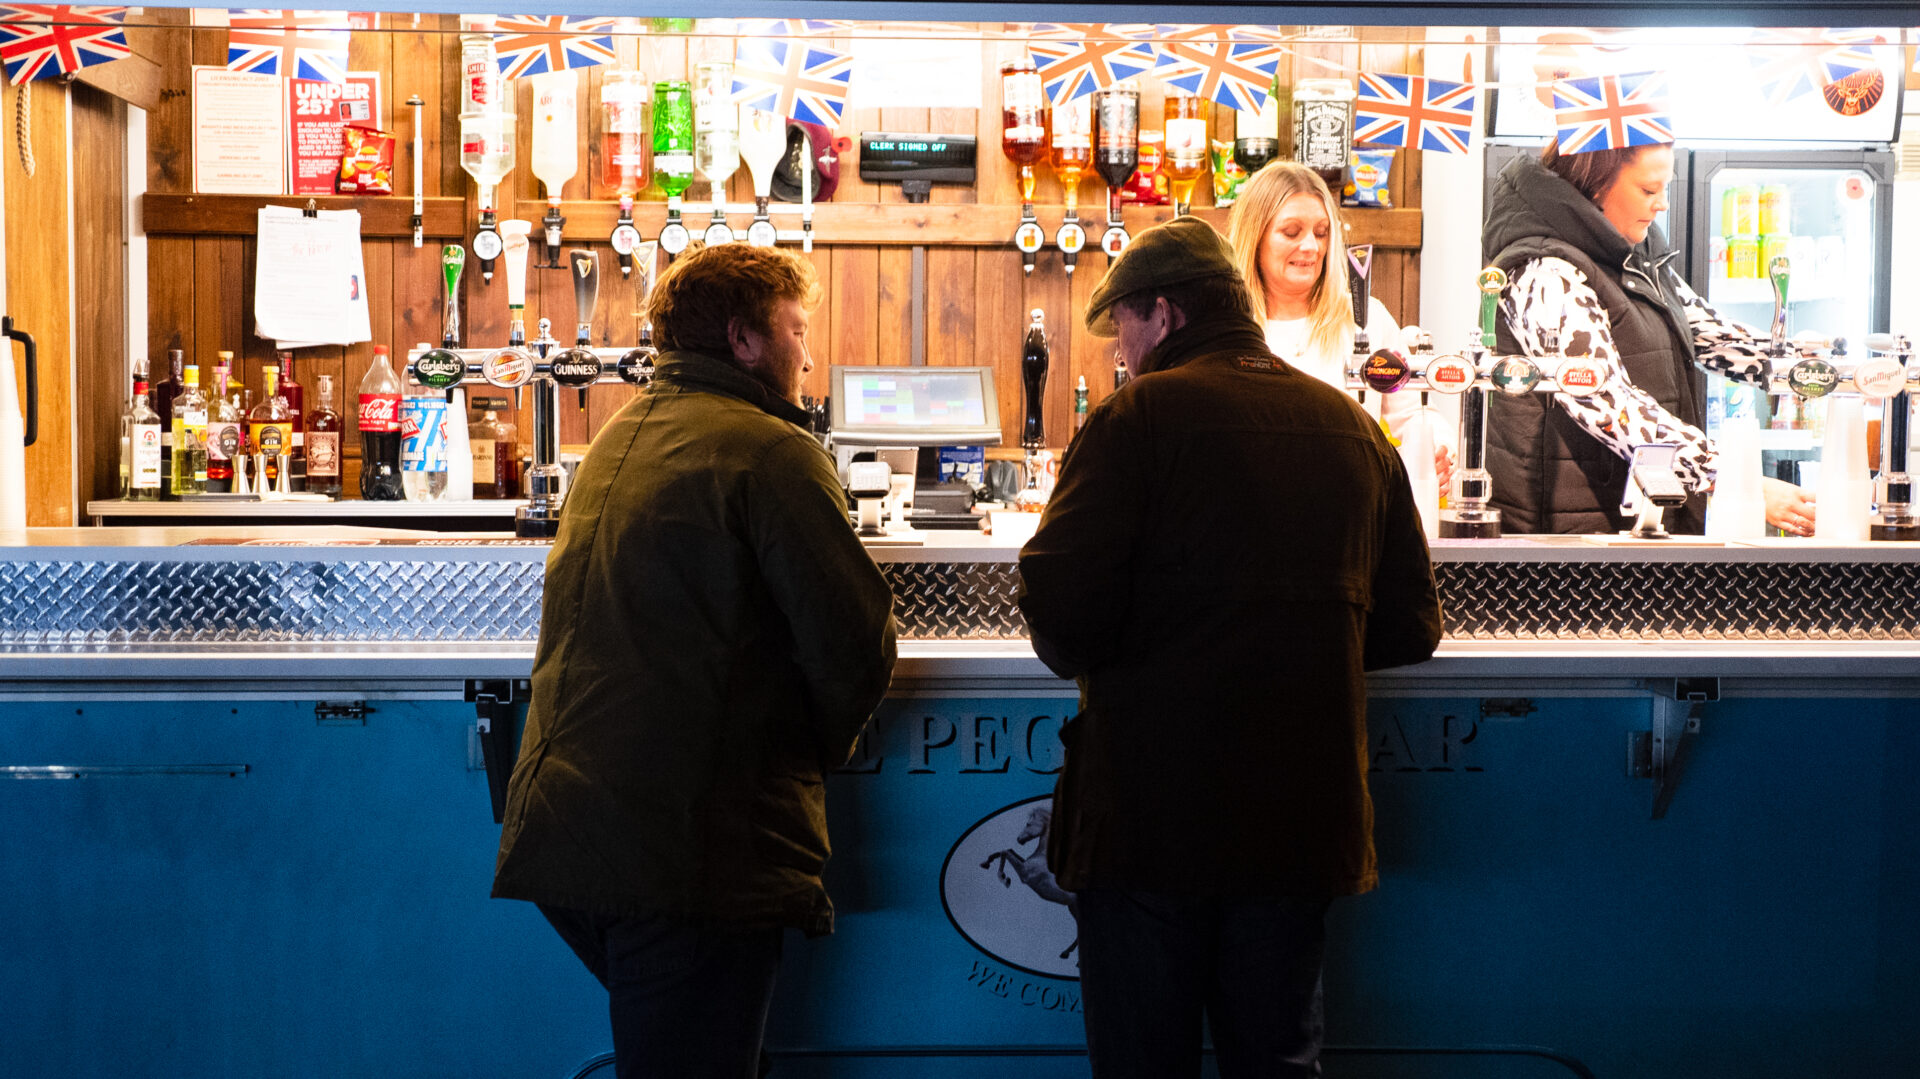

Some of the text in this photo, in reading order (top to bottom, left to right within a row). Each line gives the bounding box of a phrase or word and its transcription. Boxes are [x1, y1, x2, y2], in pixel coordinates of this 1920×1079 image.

[295, 83, 370, 99] UNDER
[296, 99, 334, 115] 25?
[869, 141, 947, 152] CLERK SIGNED OFF
[418, 359, 460, 374] Carlsberg
[554, 363, 598, 376] GUINNESS
[627, 366, 656, 376] STRONGBO
[1367, 366, 1401, 376] STRONGBOW
[1793, 367, 1835, 383] Carlsberg
[402, 419, 417, 433] ARR
[1368, 711, 1485, 773] AR
[1019, 982, 1084, 1014] COM
